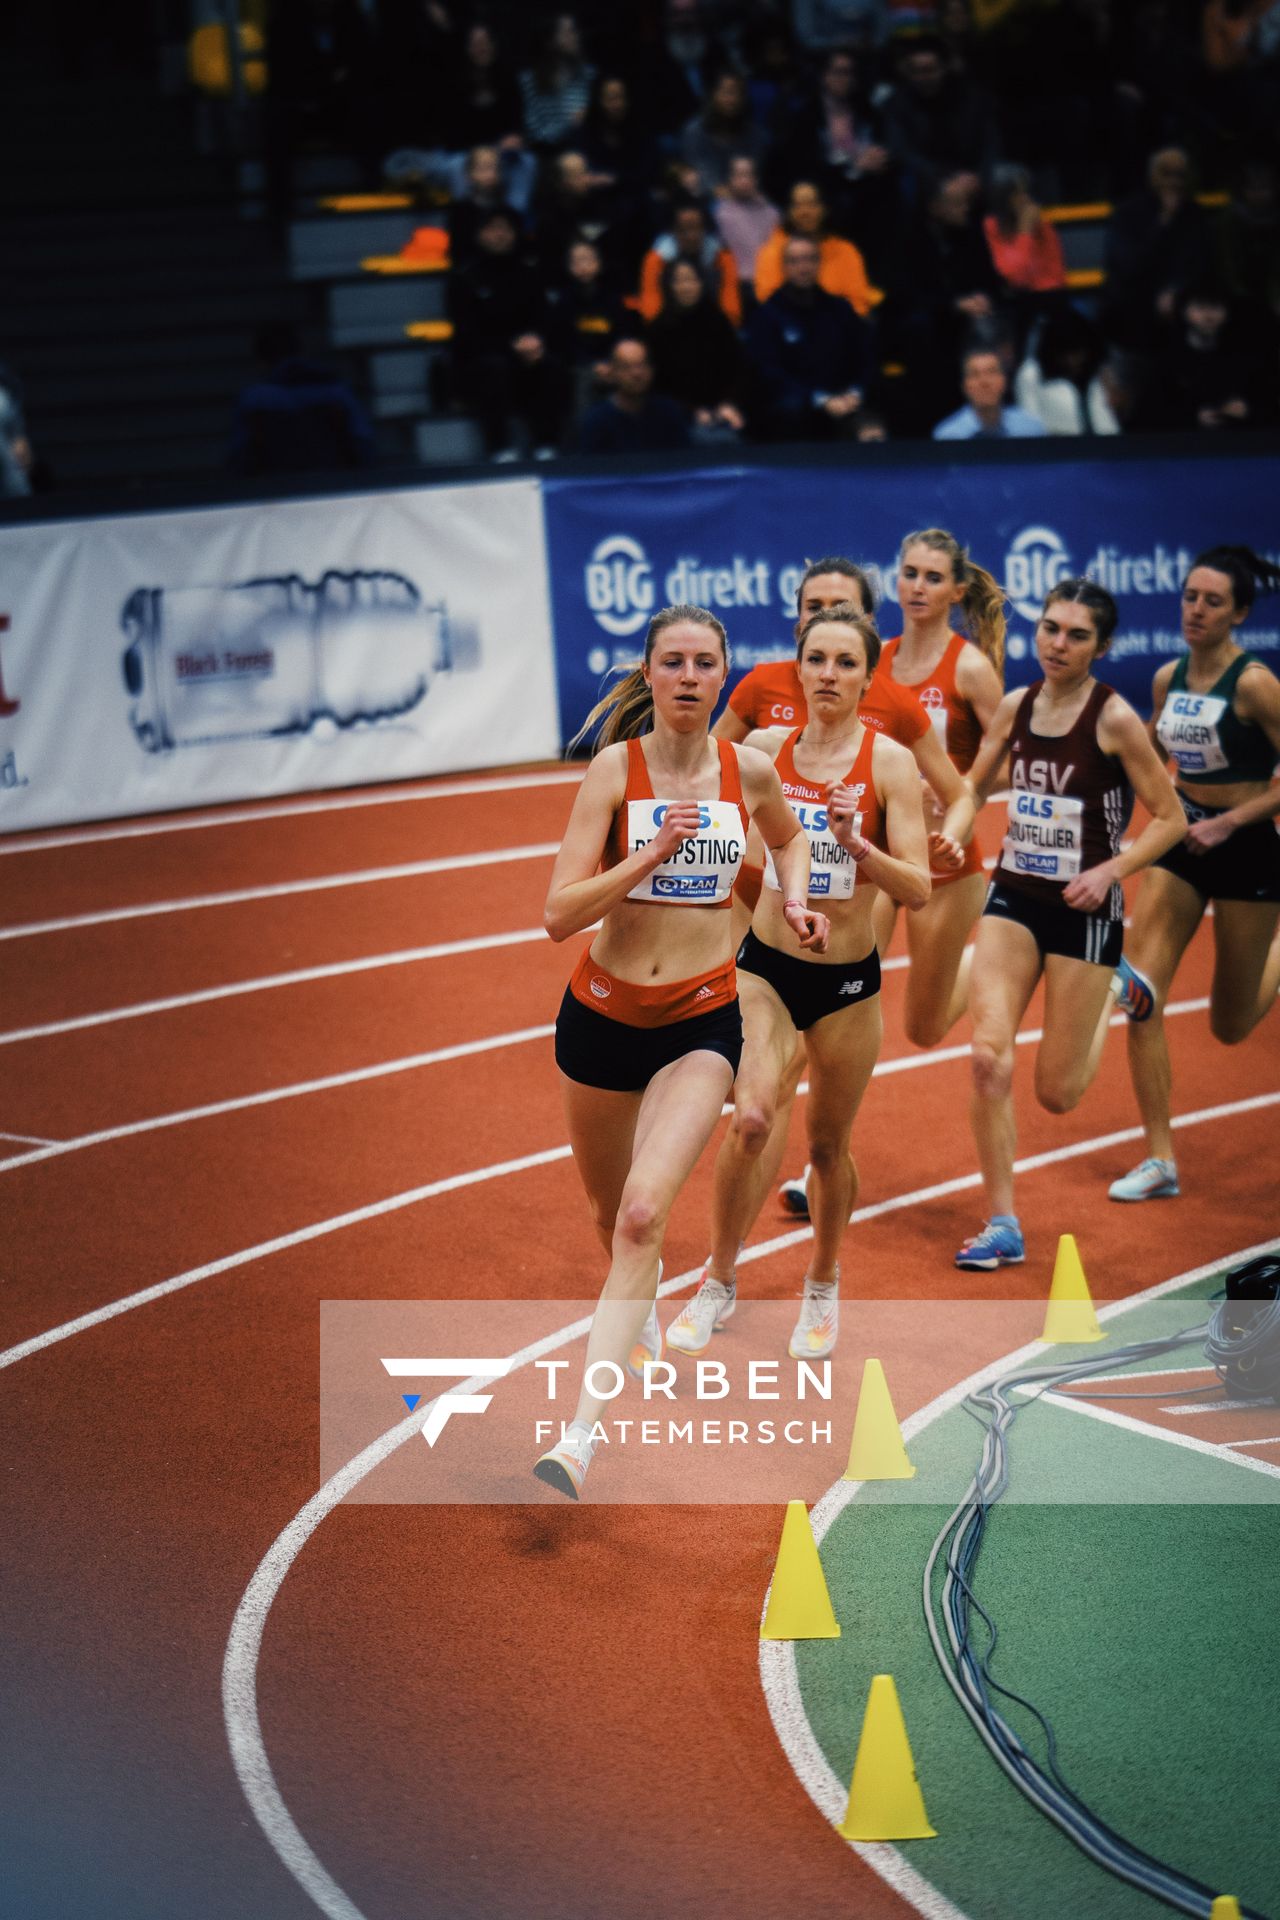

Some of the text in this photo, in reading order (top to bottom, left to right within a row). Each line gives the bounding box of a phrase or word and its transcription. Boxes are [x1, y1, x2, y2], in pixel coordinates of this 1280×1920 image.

[586, 562, 654, 612] BIG
[666, 555, 771, 607] direkt
[1012, 759, 1074, 795] ASV
[782, 783, 820, 800] Brillux
[792, 806, 829, 832] LS
[680, 879, 715, 889] PLAN
